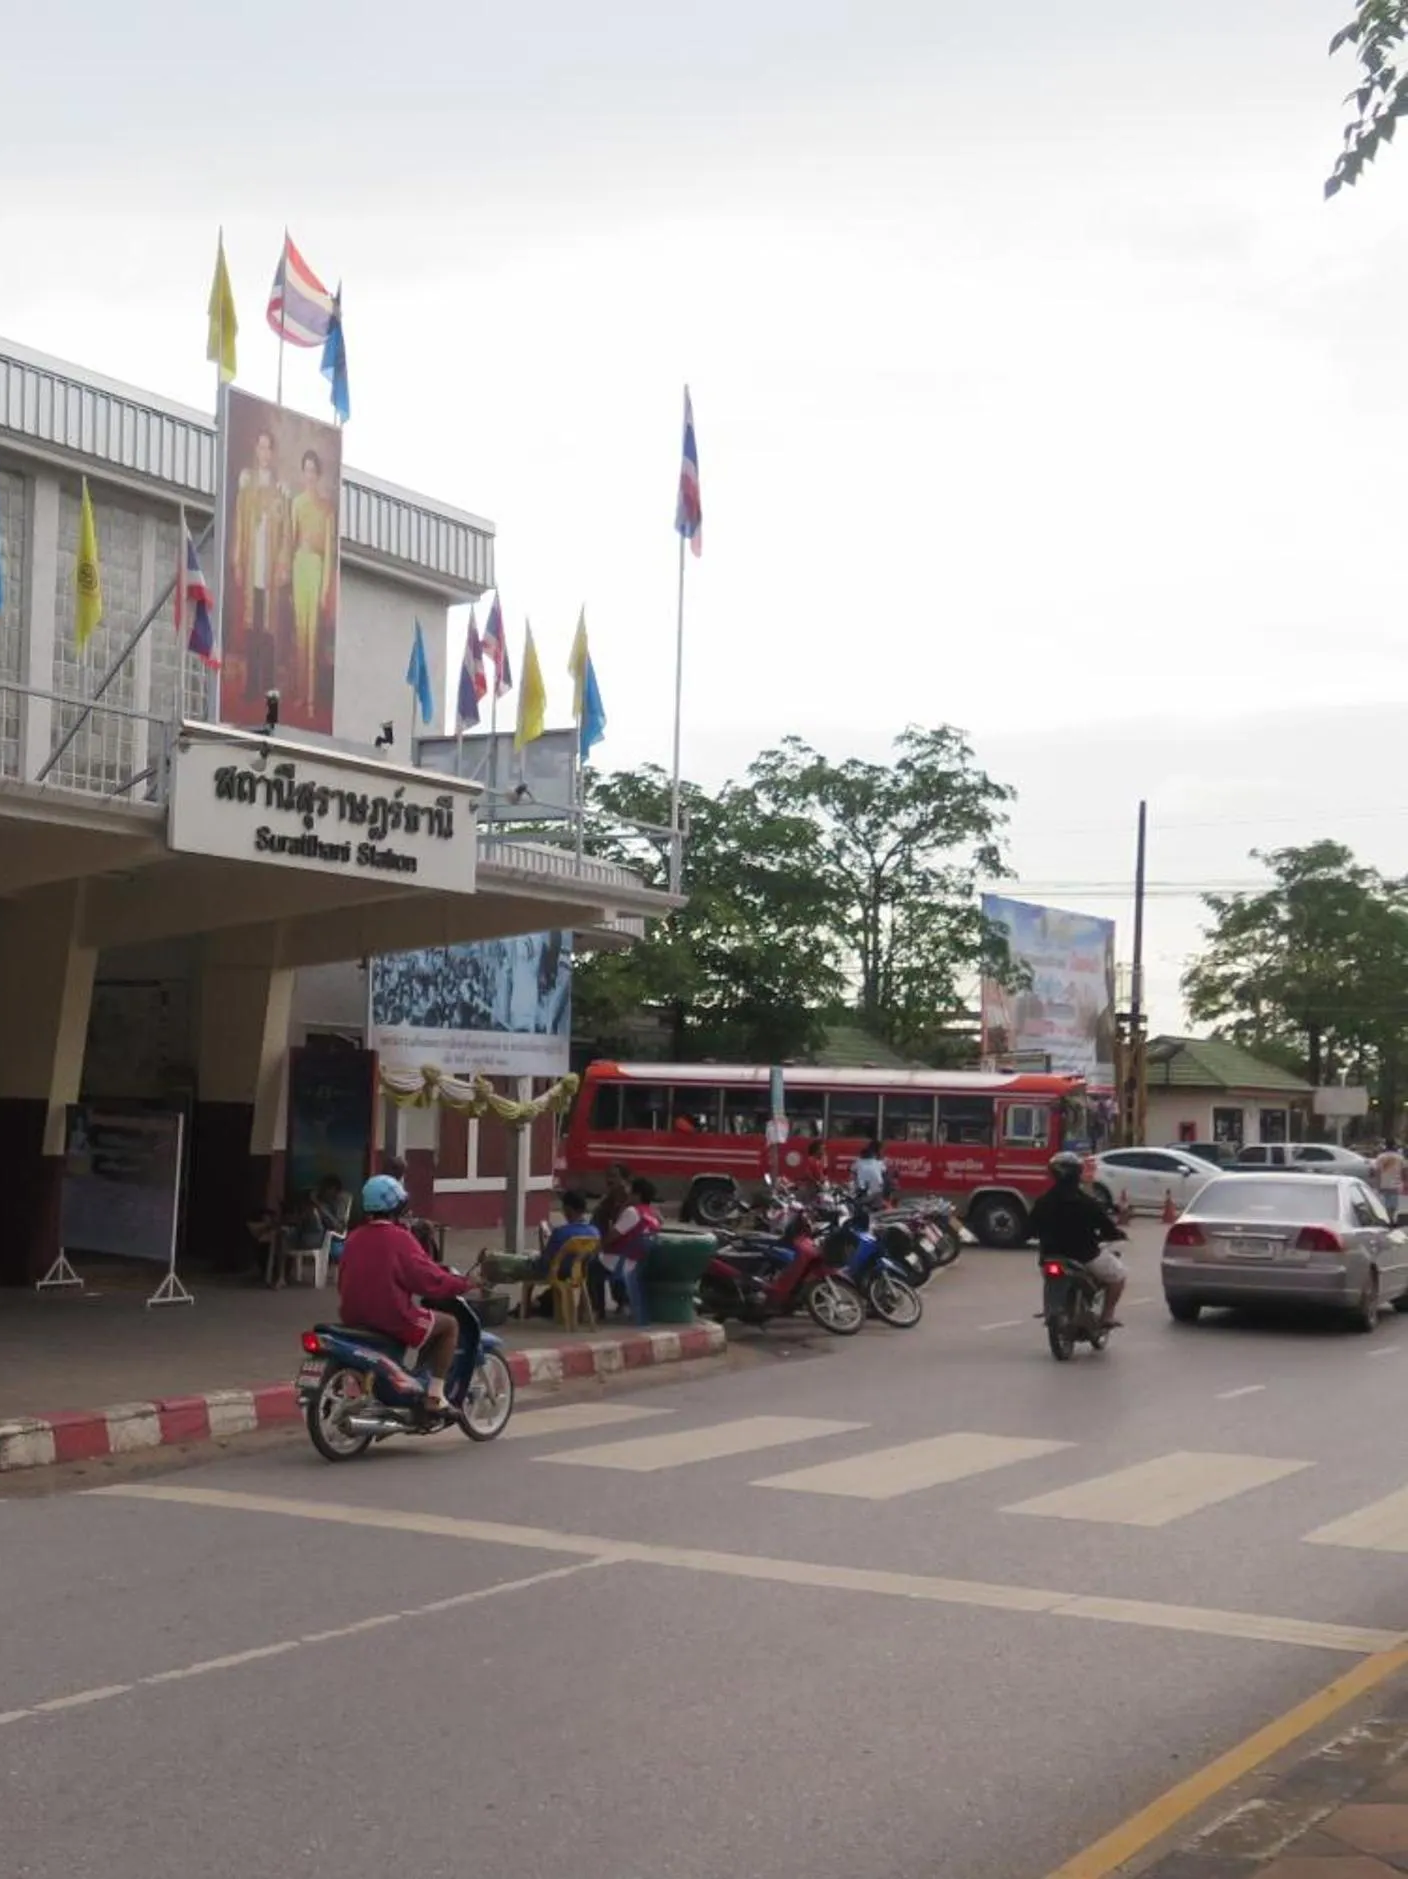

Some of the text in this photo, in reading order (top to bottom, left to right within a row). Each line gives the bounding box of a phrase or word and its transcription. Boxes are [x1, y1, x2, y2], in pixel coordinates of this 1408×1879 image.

[214, 763, 453, 839] สถานีสุราษฎร์ธานี
[356, 842, 417, 872] Station
